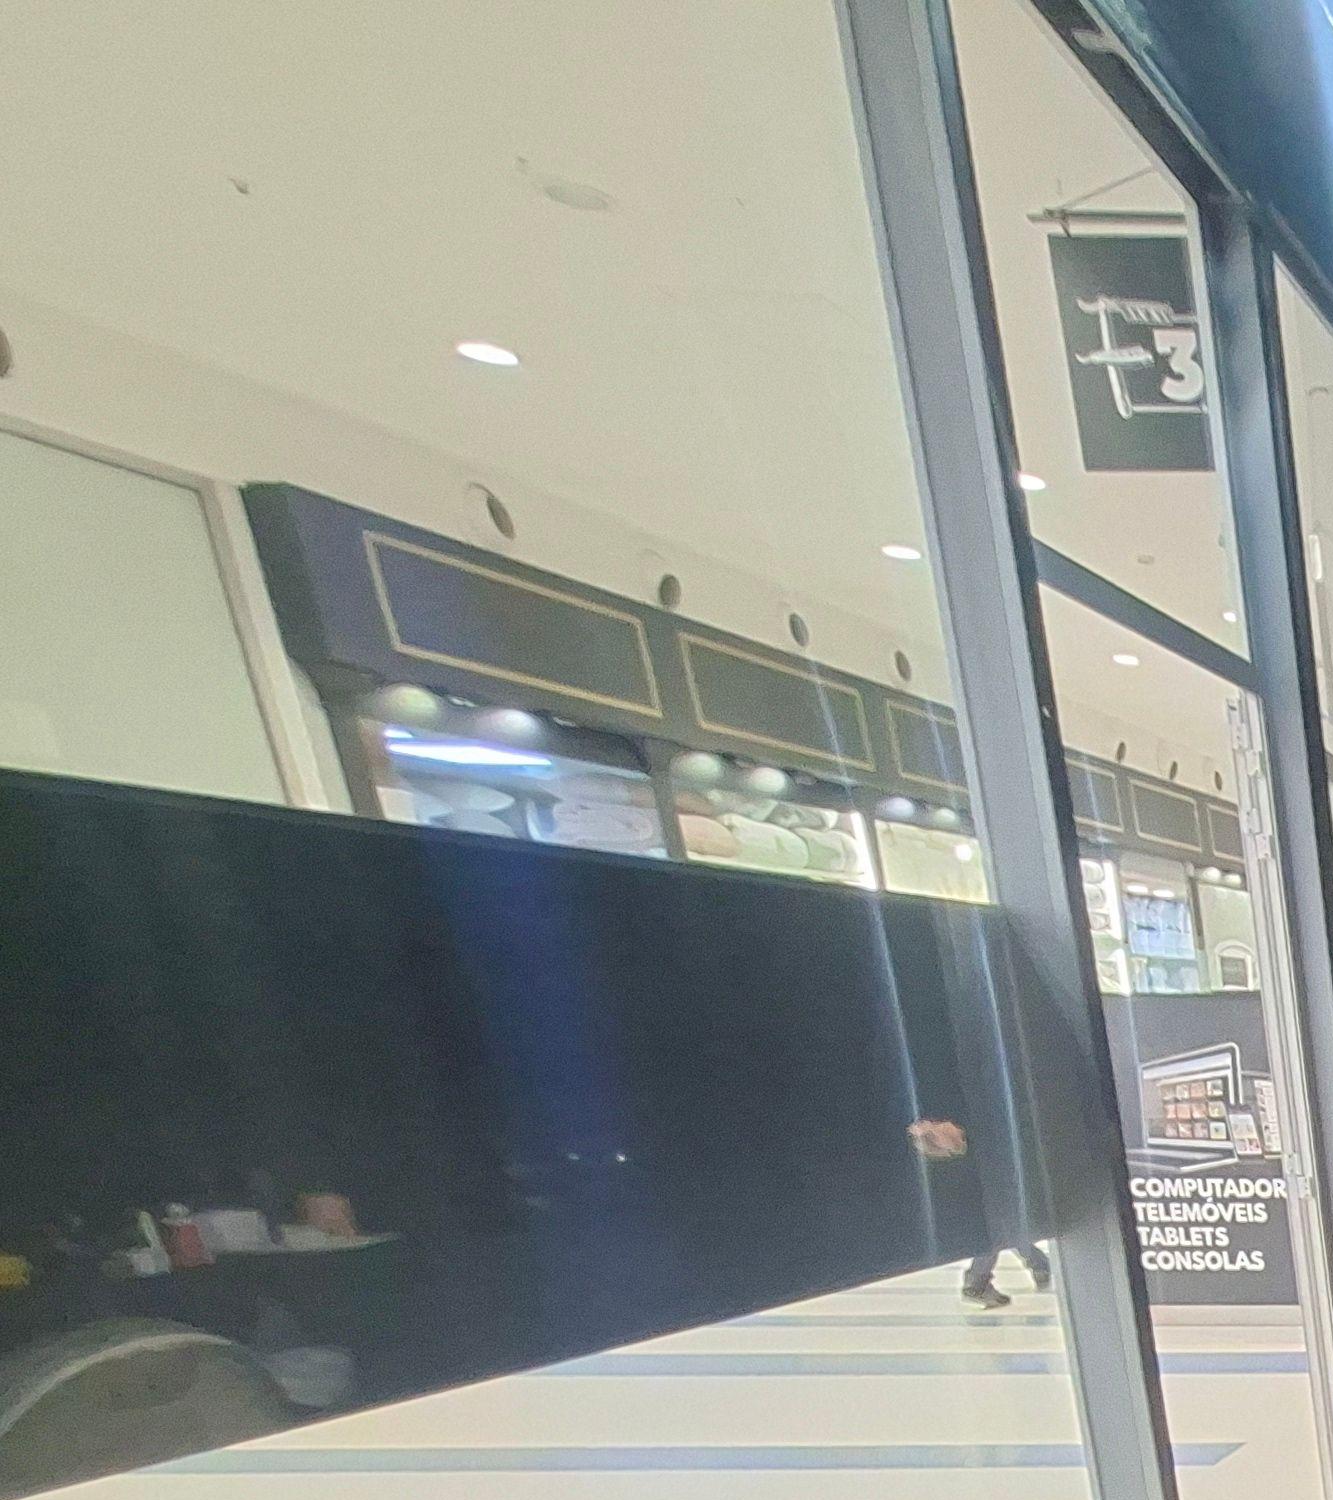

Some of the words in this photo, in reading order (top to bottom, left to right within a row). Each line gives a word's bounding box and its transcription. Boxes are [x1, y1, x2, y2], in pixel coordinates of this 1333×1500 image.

[1132, 1196, 1268, 1225] TELEMÓVEIS
[1137, 1226, 1229, 1248] TABLETS
[1140, 1250, 1266, 1272] CONSOLAS
